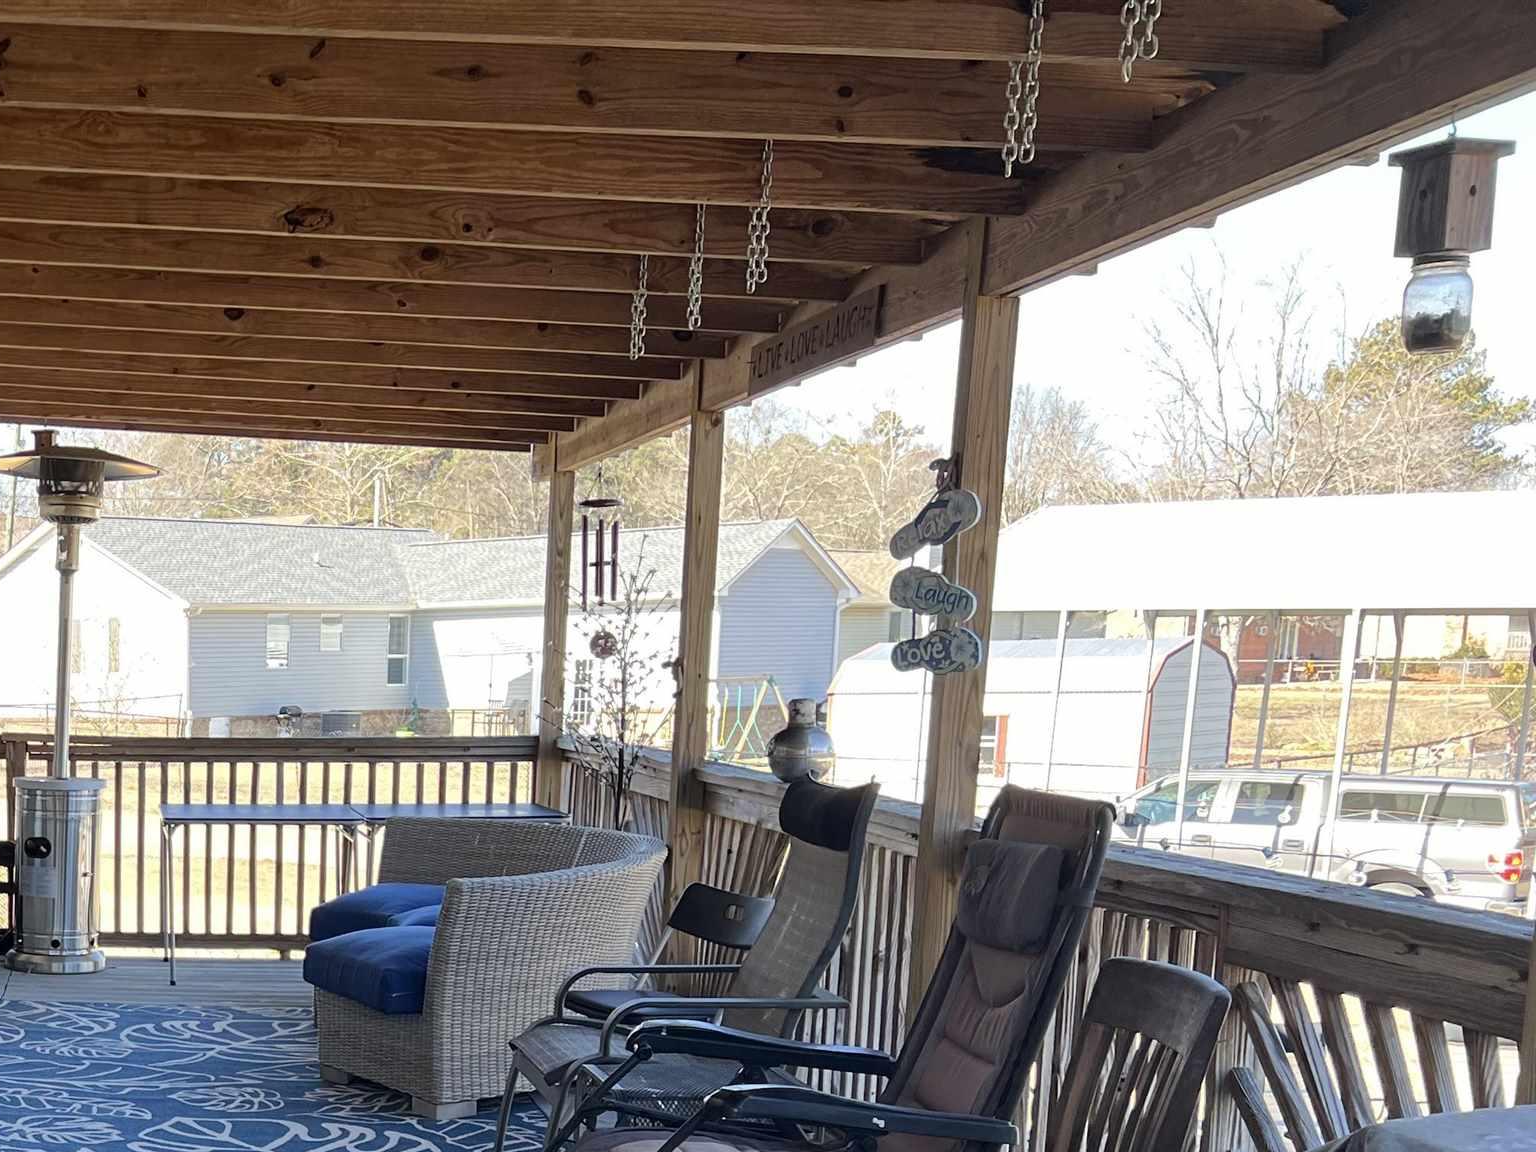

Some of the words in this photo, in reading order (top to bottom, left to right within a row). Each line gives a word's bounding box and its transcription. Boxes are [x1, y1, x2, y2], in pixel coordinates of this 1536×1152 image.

[757, 342, 784, 378] LIVE
[790, 325, 819, 364] LOVE
[825, 304, 873, 349] LAUGH
[896, 514, 946, 550] Relax
[915, 584, 970, 615] Laugh
[896, 640, 946, 666] Love
